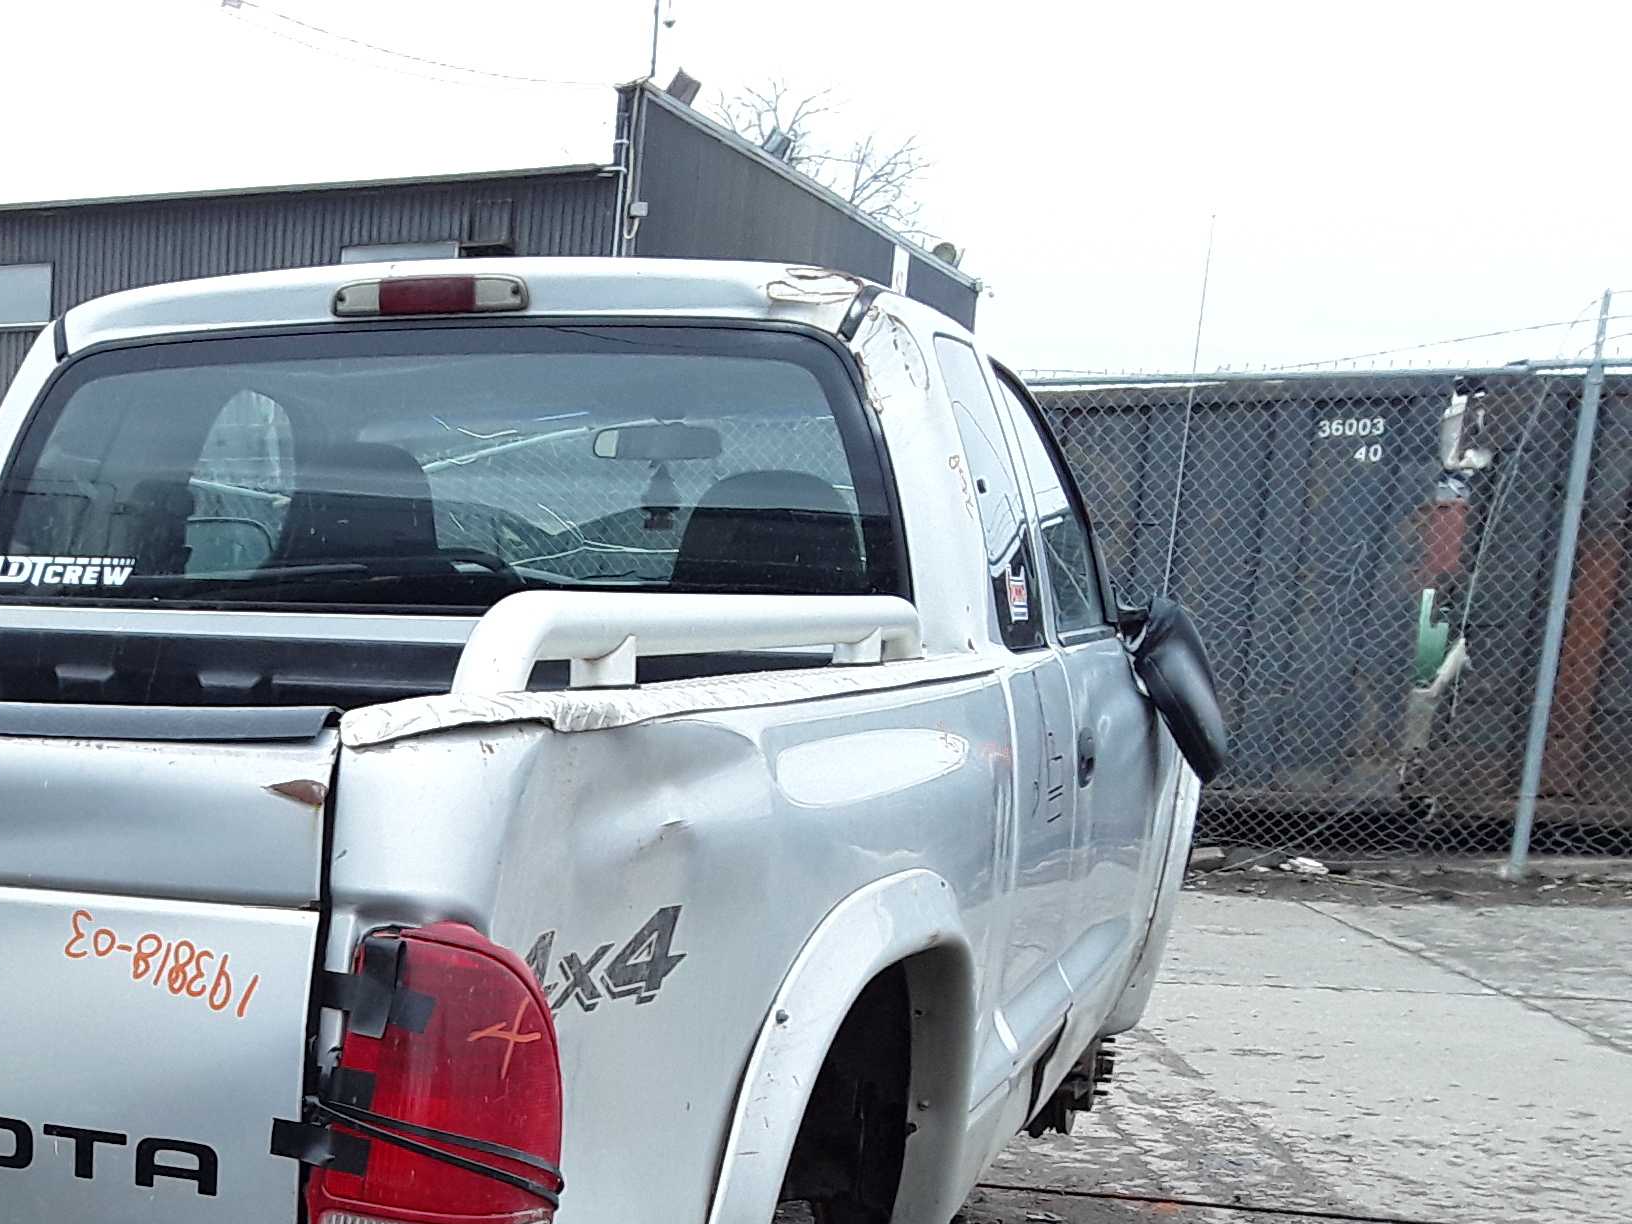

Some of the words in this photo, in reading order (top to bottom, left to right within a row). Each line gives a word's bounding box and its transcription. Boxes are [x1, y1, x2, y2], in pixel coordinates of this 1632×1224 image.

[1318, 416, 1386, 438] 36003
[1353, 444, 1383, 463] 40
[64, 909, 260, 1018] 193818-03
